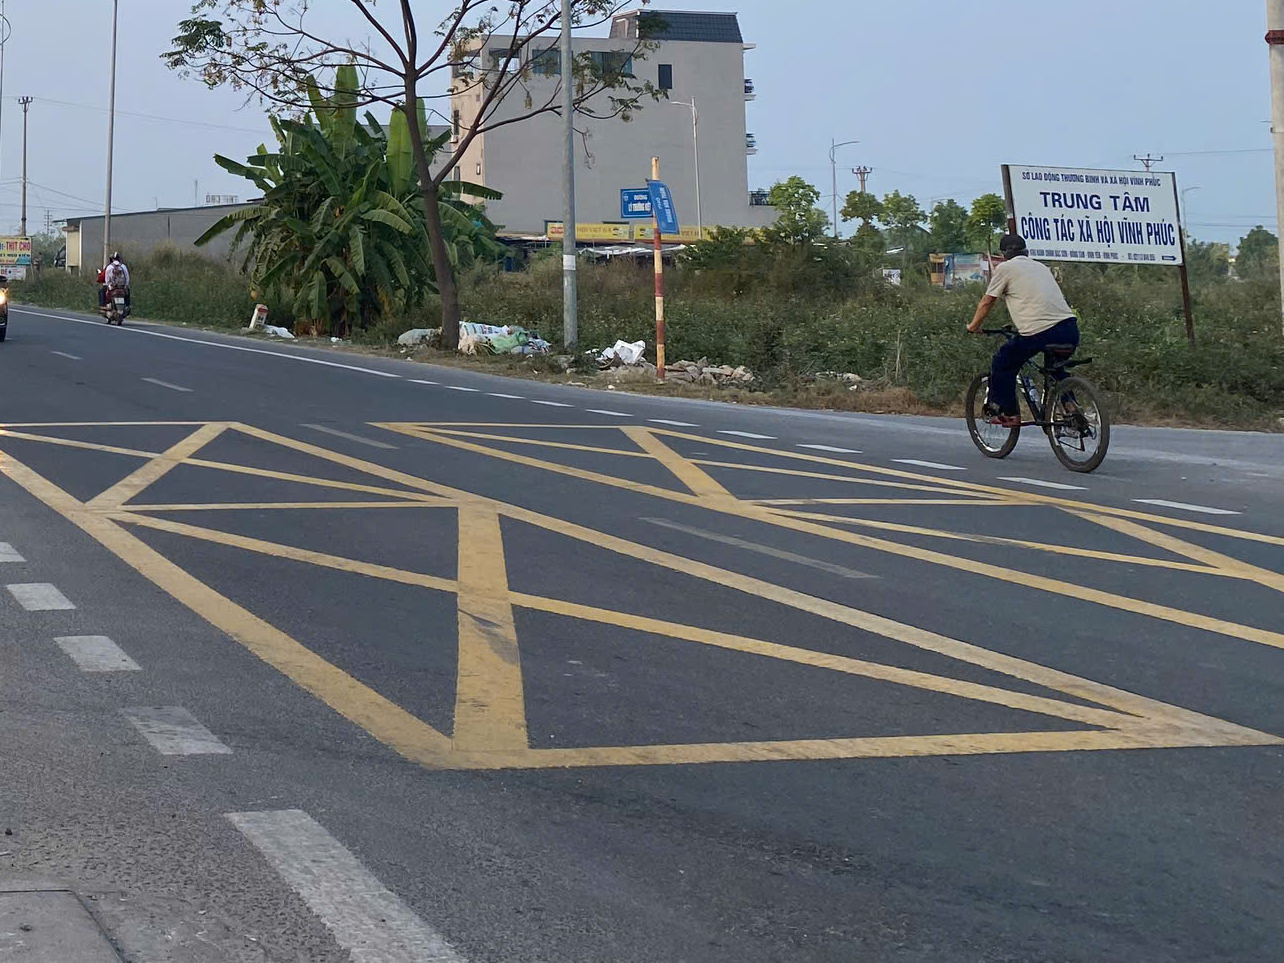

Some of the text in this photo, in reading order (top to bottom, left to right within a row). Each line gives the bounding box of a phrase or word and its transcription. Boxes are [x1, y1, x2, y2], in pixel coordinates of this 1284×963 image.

[1031, 172, 1042, 180] LAO
[1040, 191, 1150, 212] TRUNG TÂM
[1021, 212, 1175, 248] CÔNG TÁC XÃ HỘI VĨNH PHÚC
